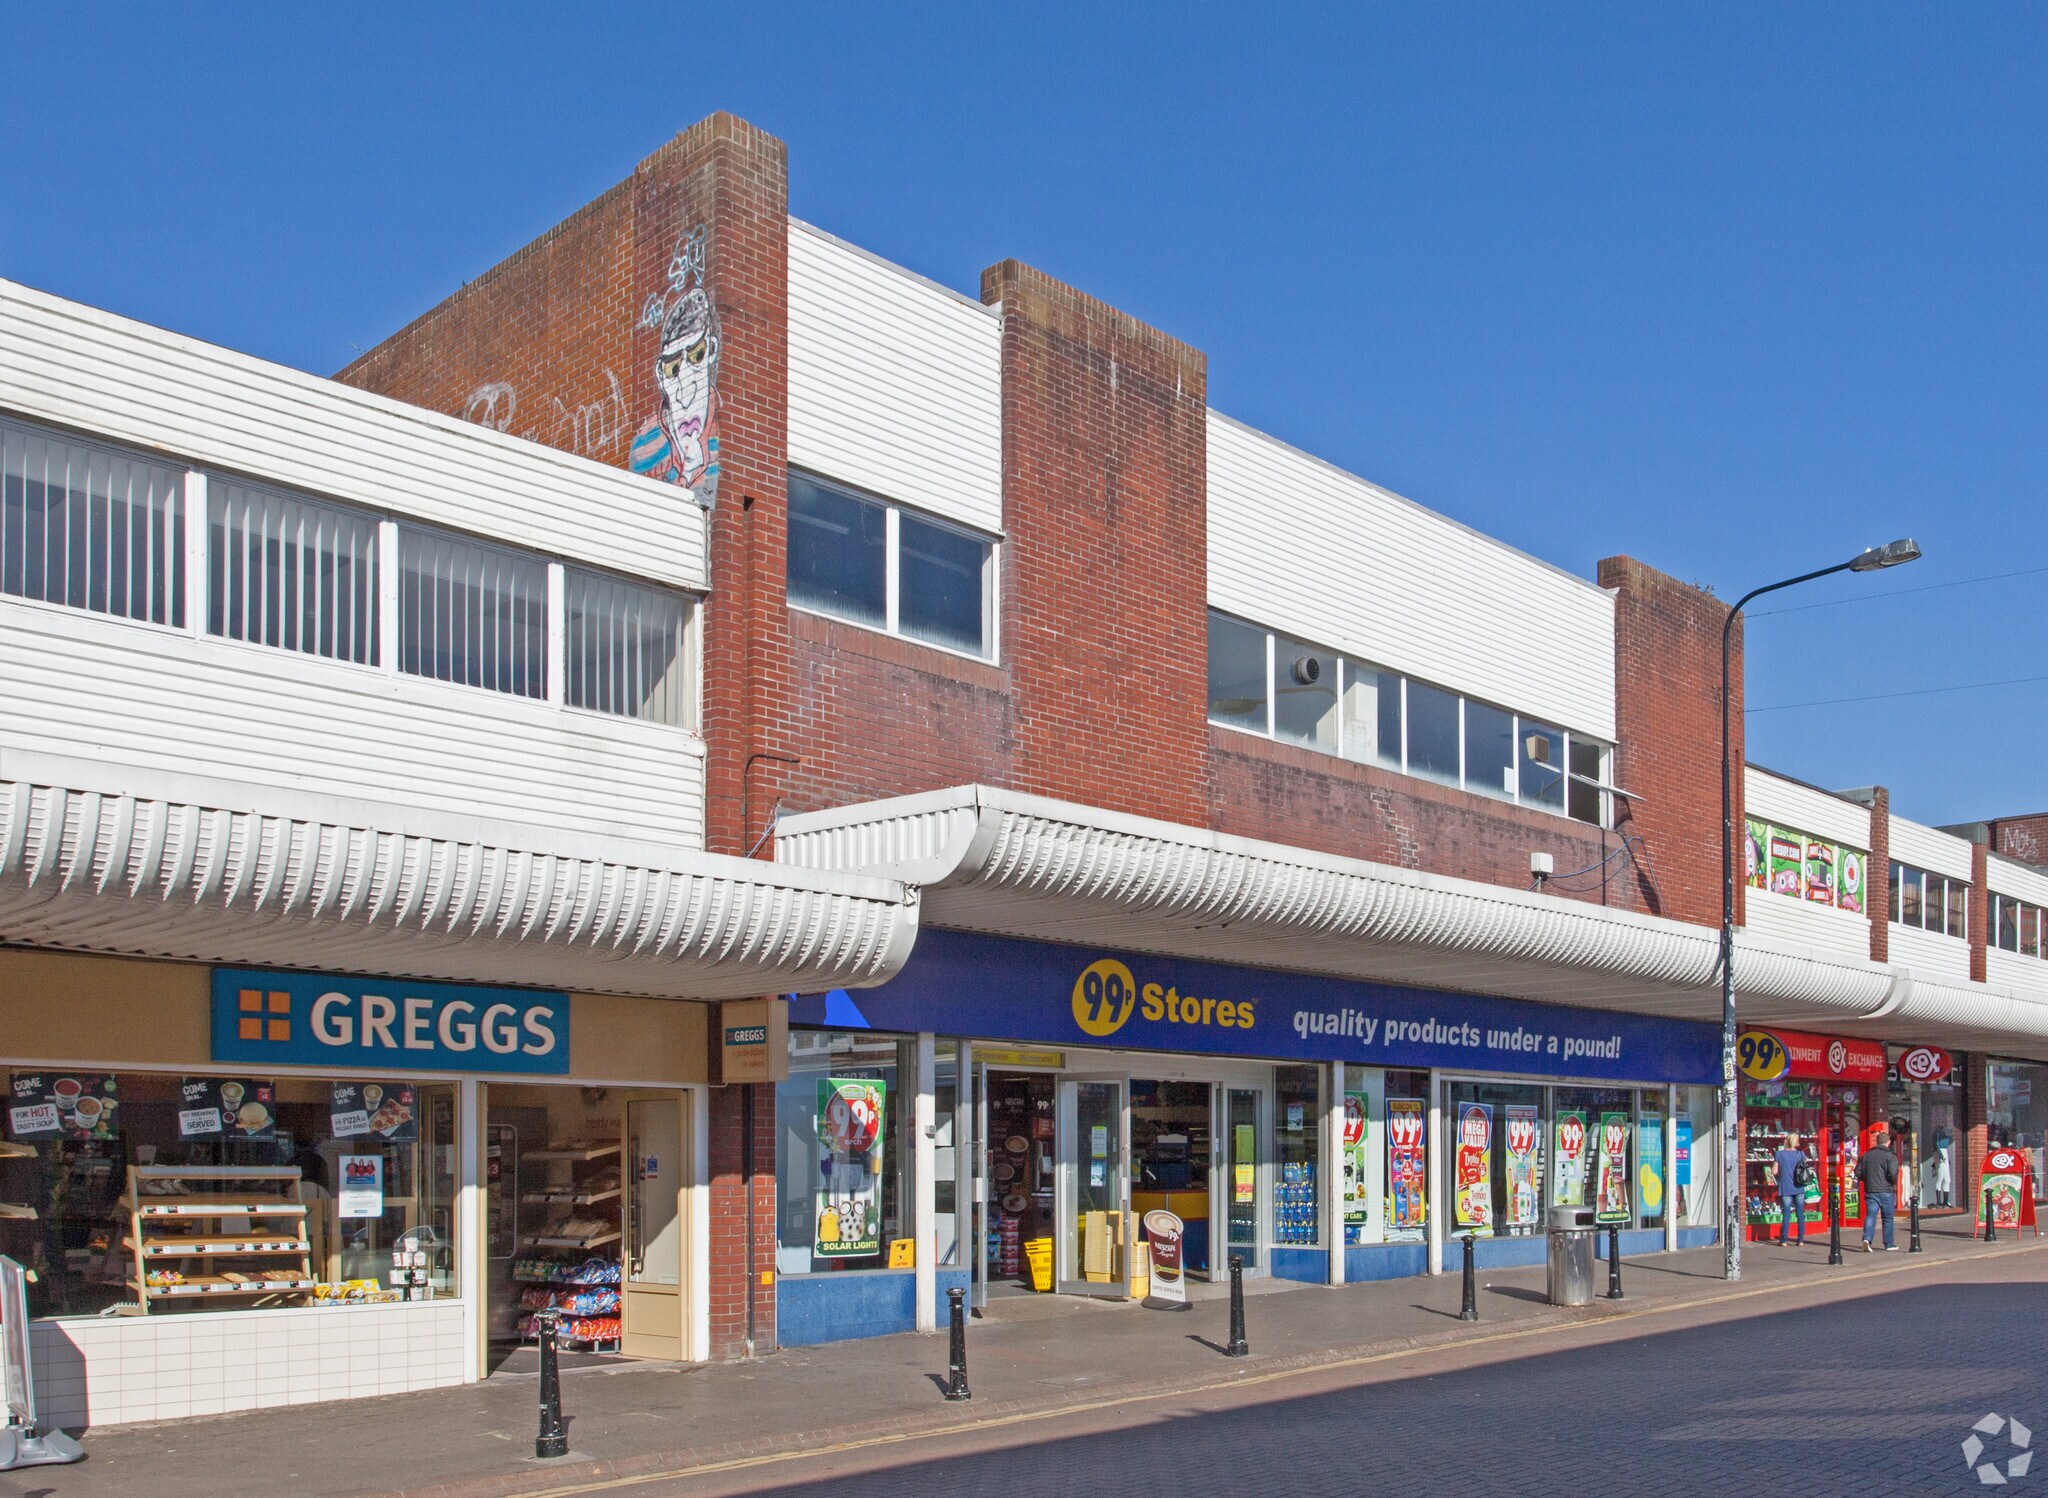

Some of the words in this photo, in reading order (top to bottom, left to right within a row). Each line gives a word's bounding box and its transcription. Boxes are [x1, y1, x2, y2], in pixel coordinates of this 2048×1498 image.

[1083, 971, 1132, 1023] 99p
[1141, 983, 1255, 1029] Stores
[310, 992, 556, 1056] GREGGS
[734, 1029, 765, 1042] GREGGS
[1293, 1008, 1378, 1045] quality
[1384, 1017, 1480, 1047] products
[1487, 1027, 1542, 1052] under
[1547, 1035, 1558, 1054] a
[1563, 1036, 1621, 1061] pound!
[1788, 1047, 1821, 1063] AINMENT
[1848, 1053, 1884, 1068] EXCHANGE
[14, 1077, 42, 1091] COME
[183, 1082, 208, 1095] COME
[334, 1087, 356, 1099] COME
[16, 1122, 35, 1130] TASTY
[36, 1120, 54, 1128] SOUP
[187, 1119, 215, 1129] SERVED
[343, 1115, 360, 1125] PIZZA
[833, 1100, 875, 1137] 99p
[1344, 1106, 1362, 1134] 9p
[1465, 1122, 1486, 1135] MEGA
[1464, 1134, 1486, 1148] VALUE
[823, 1241, 851, 1251] SOLAR
[853, 1240, 878, 1250] LIGHTS
